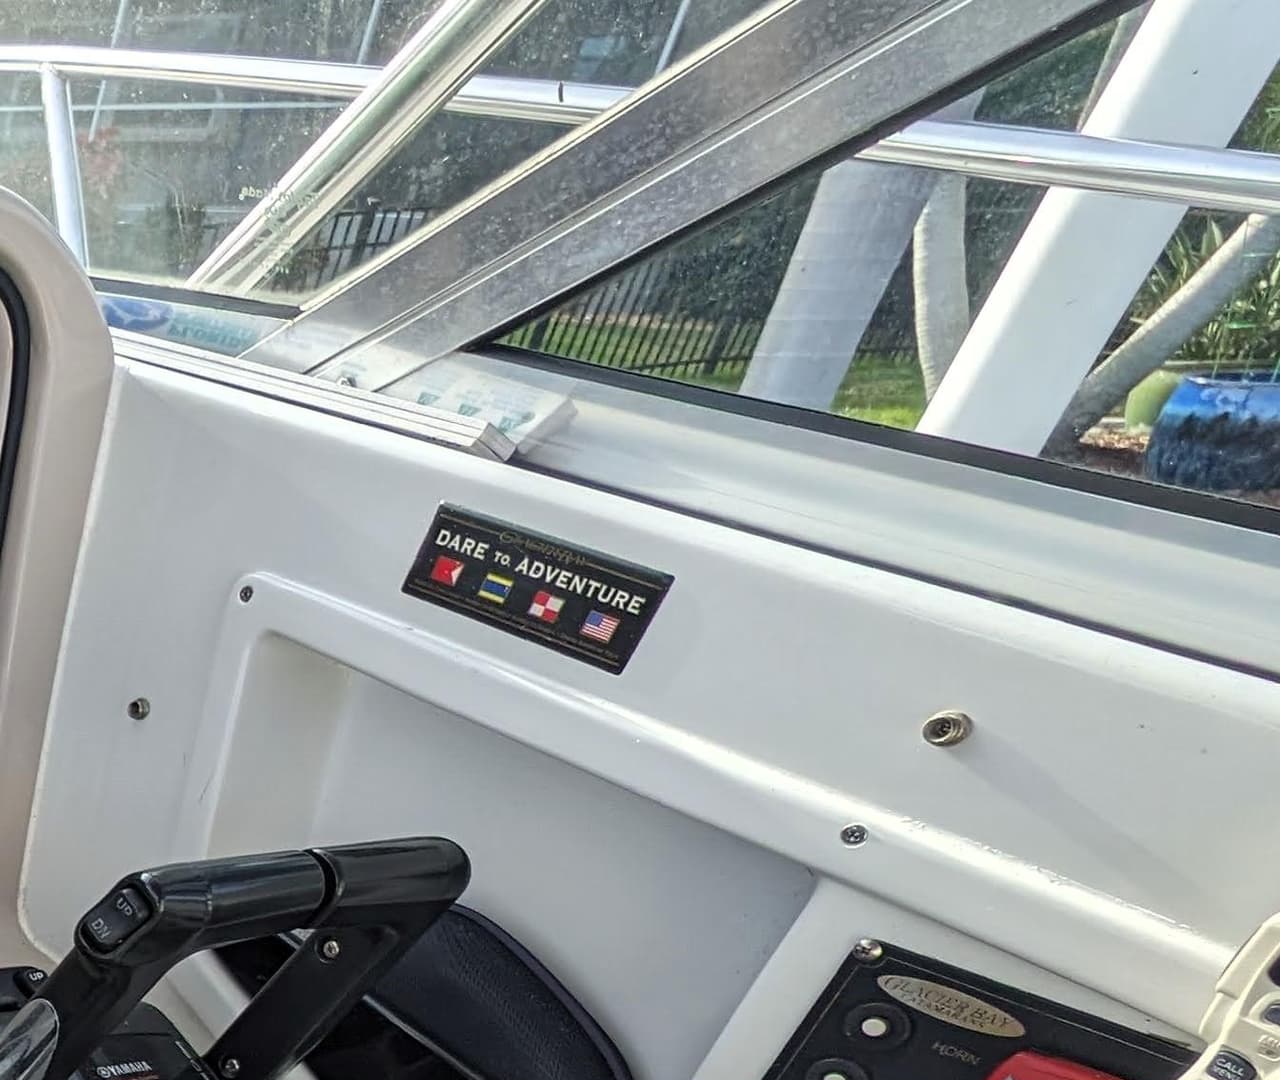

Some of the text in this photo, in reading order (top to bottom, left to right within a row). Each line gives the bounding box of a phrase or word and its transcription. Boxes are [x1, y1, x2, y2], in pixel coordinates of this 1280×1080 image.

[435, 528, 490, 560] DARE
[493, 550, 512, 567] TO
[514, 557, 646, 616] ADVENTURE
[115, 897, 133, 917] UP
[91, 917, 112, 940] DN
[28, 971, 44, 981] UP
[883, 976, 1011, 1029] GLACIER BAY
[932, 1041, 982, 1065] HORN
[106, 1060, 153, 1076] YAMAHA
[1216, 1057, 1245, 1077] CALL
